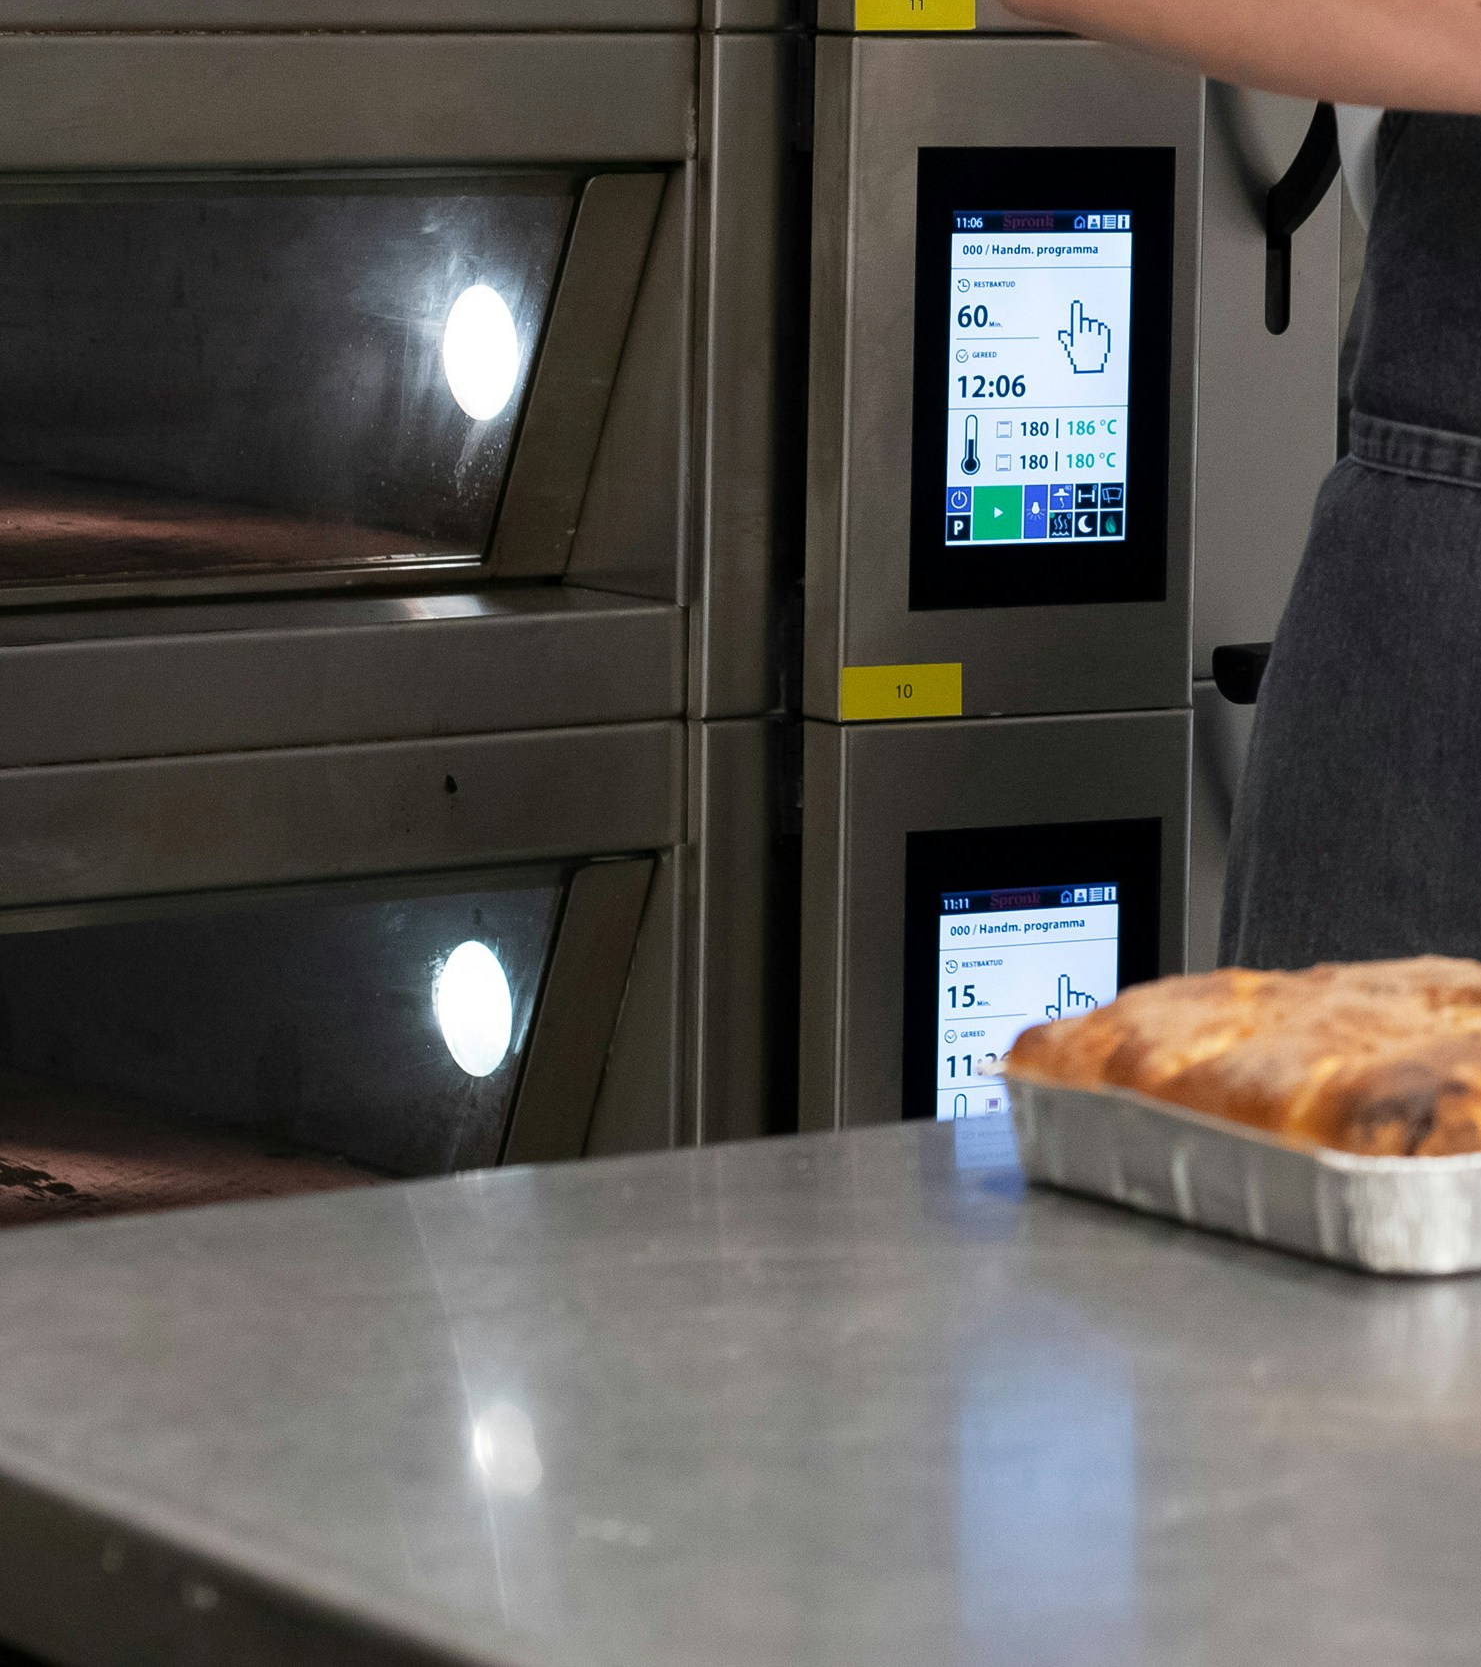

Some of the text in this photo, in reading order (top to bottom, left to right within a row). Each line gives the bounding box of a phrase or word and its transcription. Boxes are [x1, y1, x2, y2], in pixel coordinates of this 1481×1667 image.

[955, 217, 984, 229] 11:06
[962, 245, 983, 255] 000
[992, 244, 1034, 255] Handm.
[1037, 245, 1099, 257] programma
[957, 305, 989, 328] 60
[957, 374, 1026, 399] 12:06
[1020, 421, 1049, 437] 180
[1067, 420, 1096, 436] 186
[1019, 454, 1049, 470] 180
[1066, 453, 1095, 469] 180
[953, 520, 964, 536] P
[896, 684, 913, 699] 10
[943, 898, 970, 910] 11:11
[950, 925, 971, 936] 000
[979, 922, 1022, 935] Handm.
[1023, 918, 1086, 934] programma
[947, 984, 976, 1009] 15
[946, 1050, 1010, 1078] 11:
